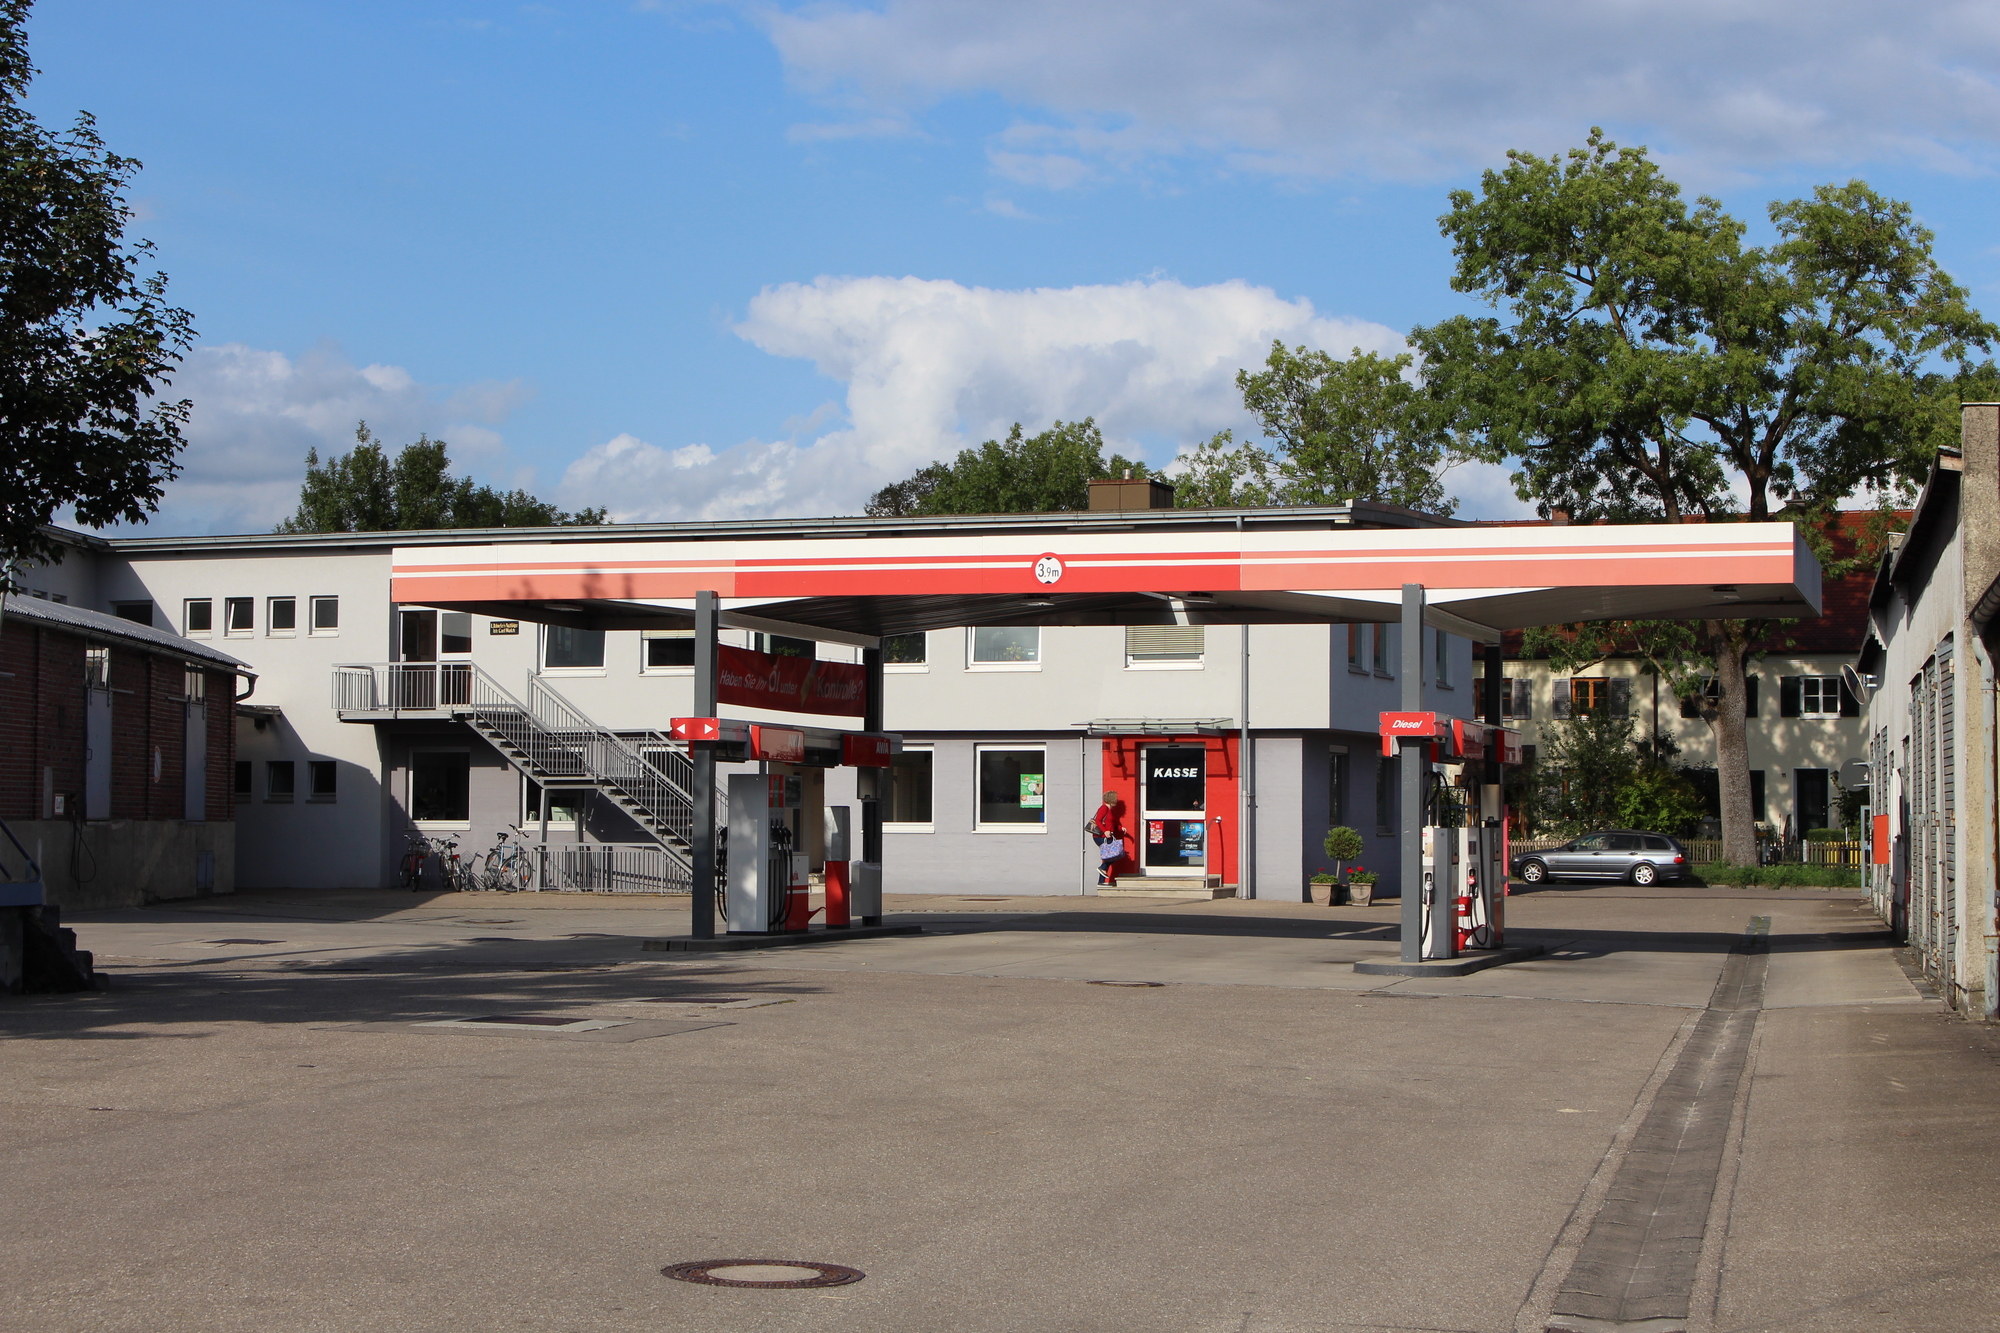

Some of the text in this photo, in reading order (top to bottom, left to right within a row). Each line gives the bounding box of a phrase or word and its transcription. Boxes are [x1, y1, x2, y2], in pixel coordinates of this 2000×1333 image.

[719, 669, 742, 687] Haben
[743, 673, 755, 689] Sie
[755, 679, 768, 690] Ihr
[780, 683, 799, 695] unter
[816, 676, 864, 700] Kontrolle?
[1391, 720, 1423, 729] Diesel
[787, 734, 803, 748] AVIA
[876, 740, 889, 755] AVIA
[1153, 767, 1199, 778] KASSE
